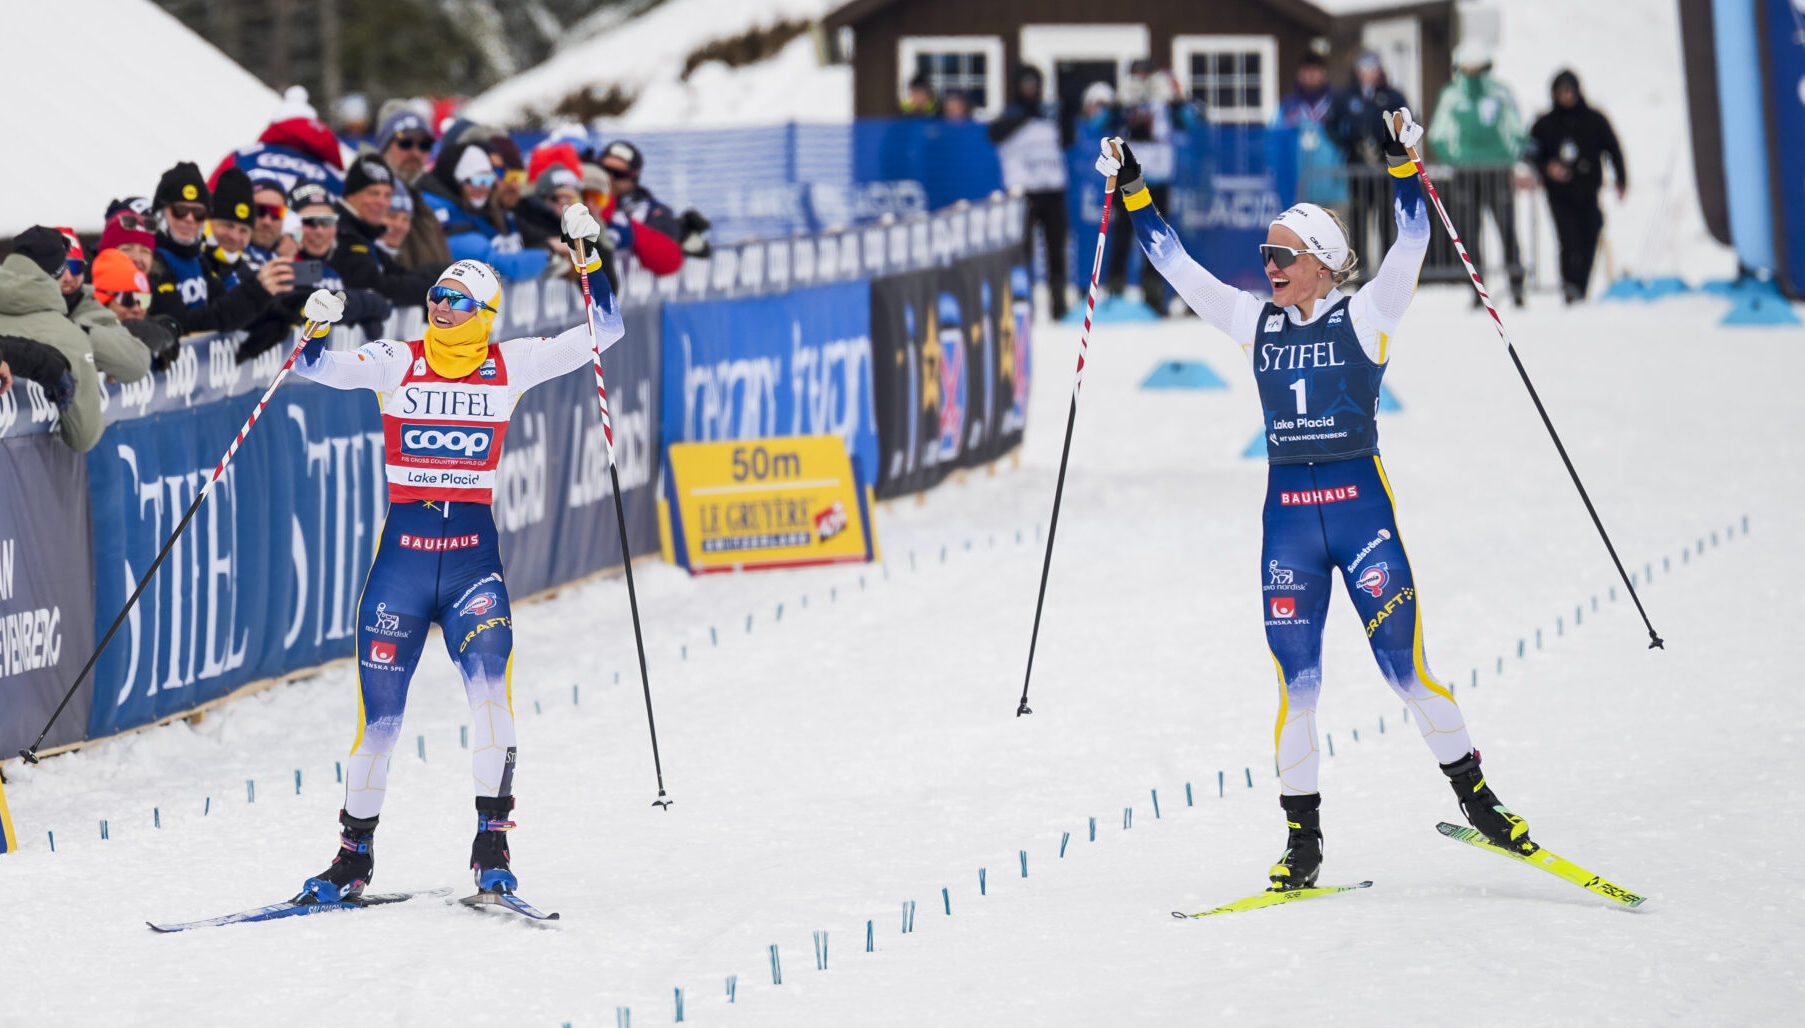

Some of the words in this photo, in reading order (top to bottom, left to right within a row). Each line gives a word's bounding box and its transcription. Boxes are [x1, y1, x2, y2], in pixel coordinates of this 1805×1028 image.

[1259, 341, 1346, 372] STIFEL
[403, 387, 496, 417] STIFEL
[1289, 378, 1308, 415] 1
[1273, 419, 1295, 430] Lake
[1296, 416, 1335, 428] Placid
[1301, 431, 1348, 441] HOEVENBERG
[404, 429, 489, 456] coop
[408, 471, 437, 483] Lake
[441, 473, 480, 485] Placid
[732, 446, 801, 482] 50m
[1282, 486, 1358, 503] BAUHAUS
[401, 535, 479, 550] BAUHAUS
[1367, 593, 1404, 638] CRAFT
[460, 617, 507, 653] CRAFT
